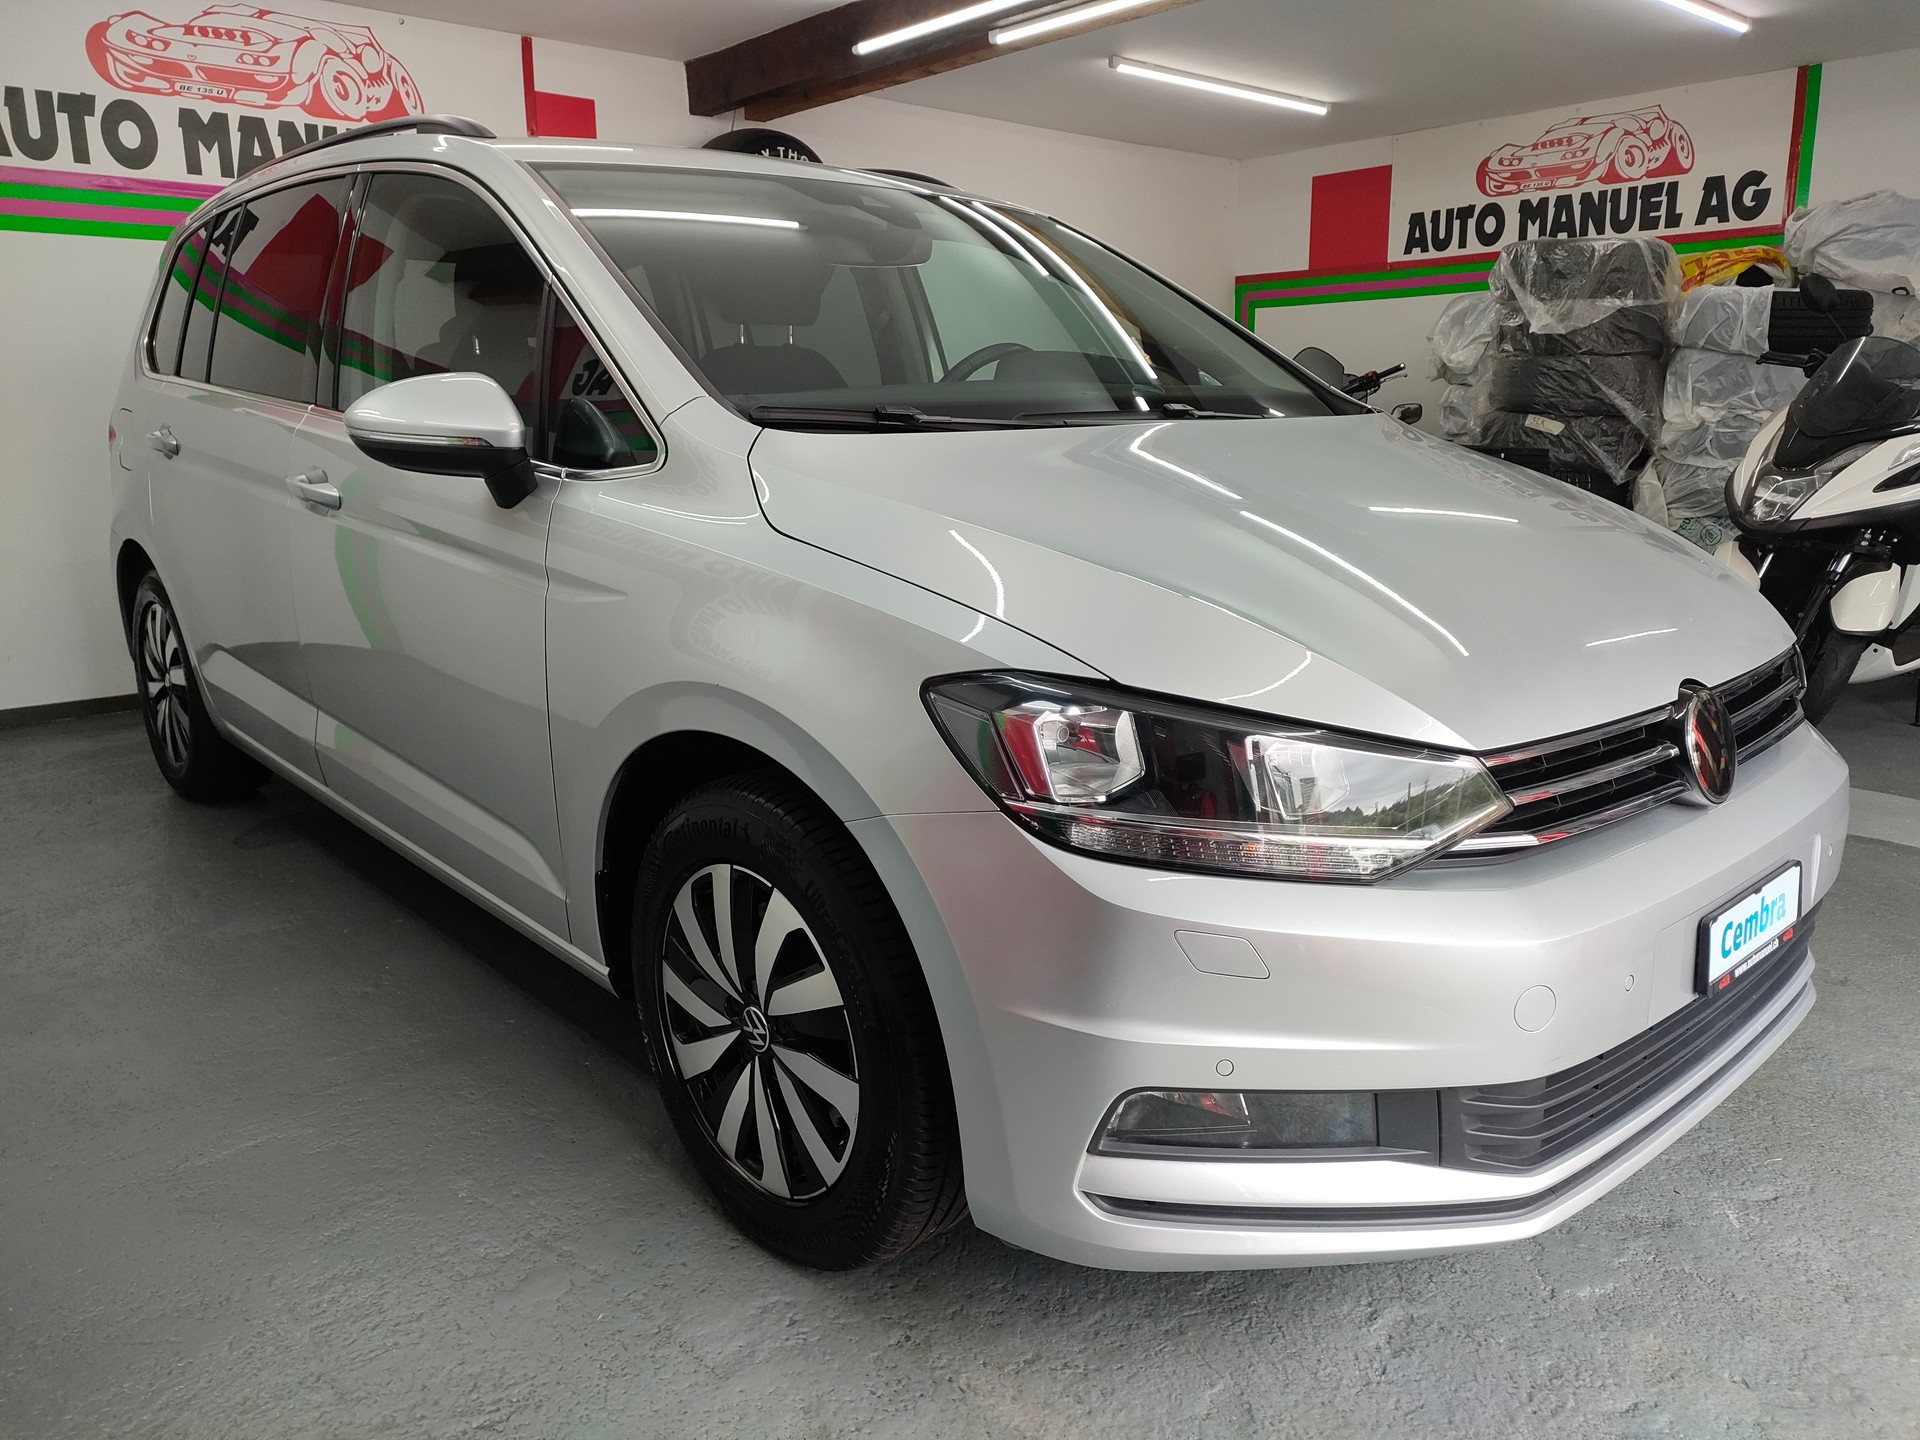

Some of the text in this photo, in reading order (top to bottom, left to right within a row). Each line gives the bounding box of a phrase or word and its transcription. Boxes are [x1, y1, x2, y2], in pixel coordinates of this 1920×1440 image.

[179, 84, 193, 92] BE
[196, 87, 214, 95] 135
[178, 107, 352, 179] MAN
[1404, 170, 1772, 255] AUTO MANUEL AG
[1721, 893, 1787, 959] Cembra
